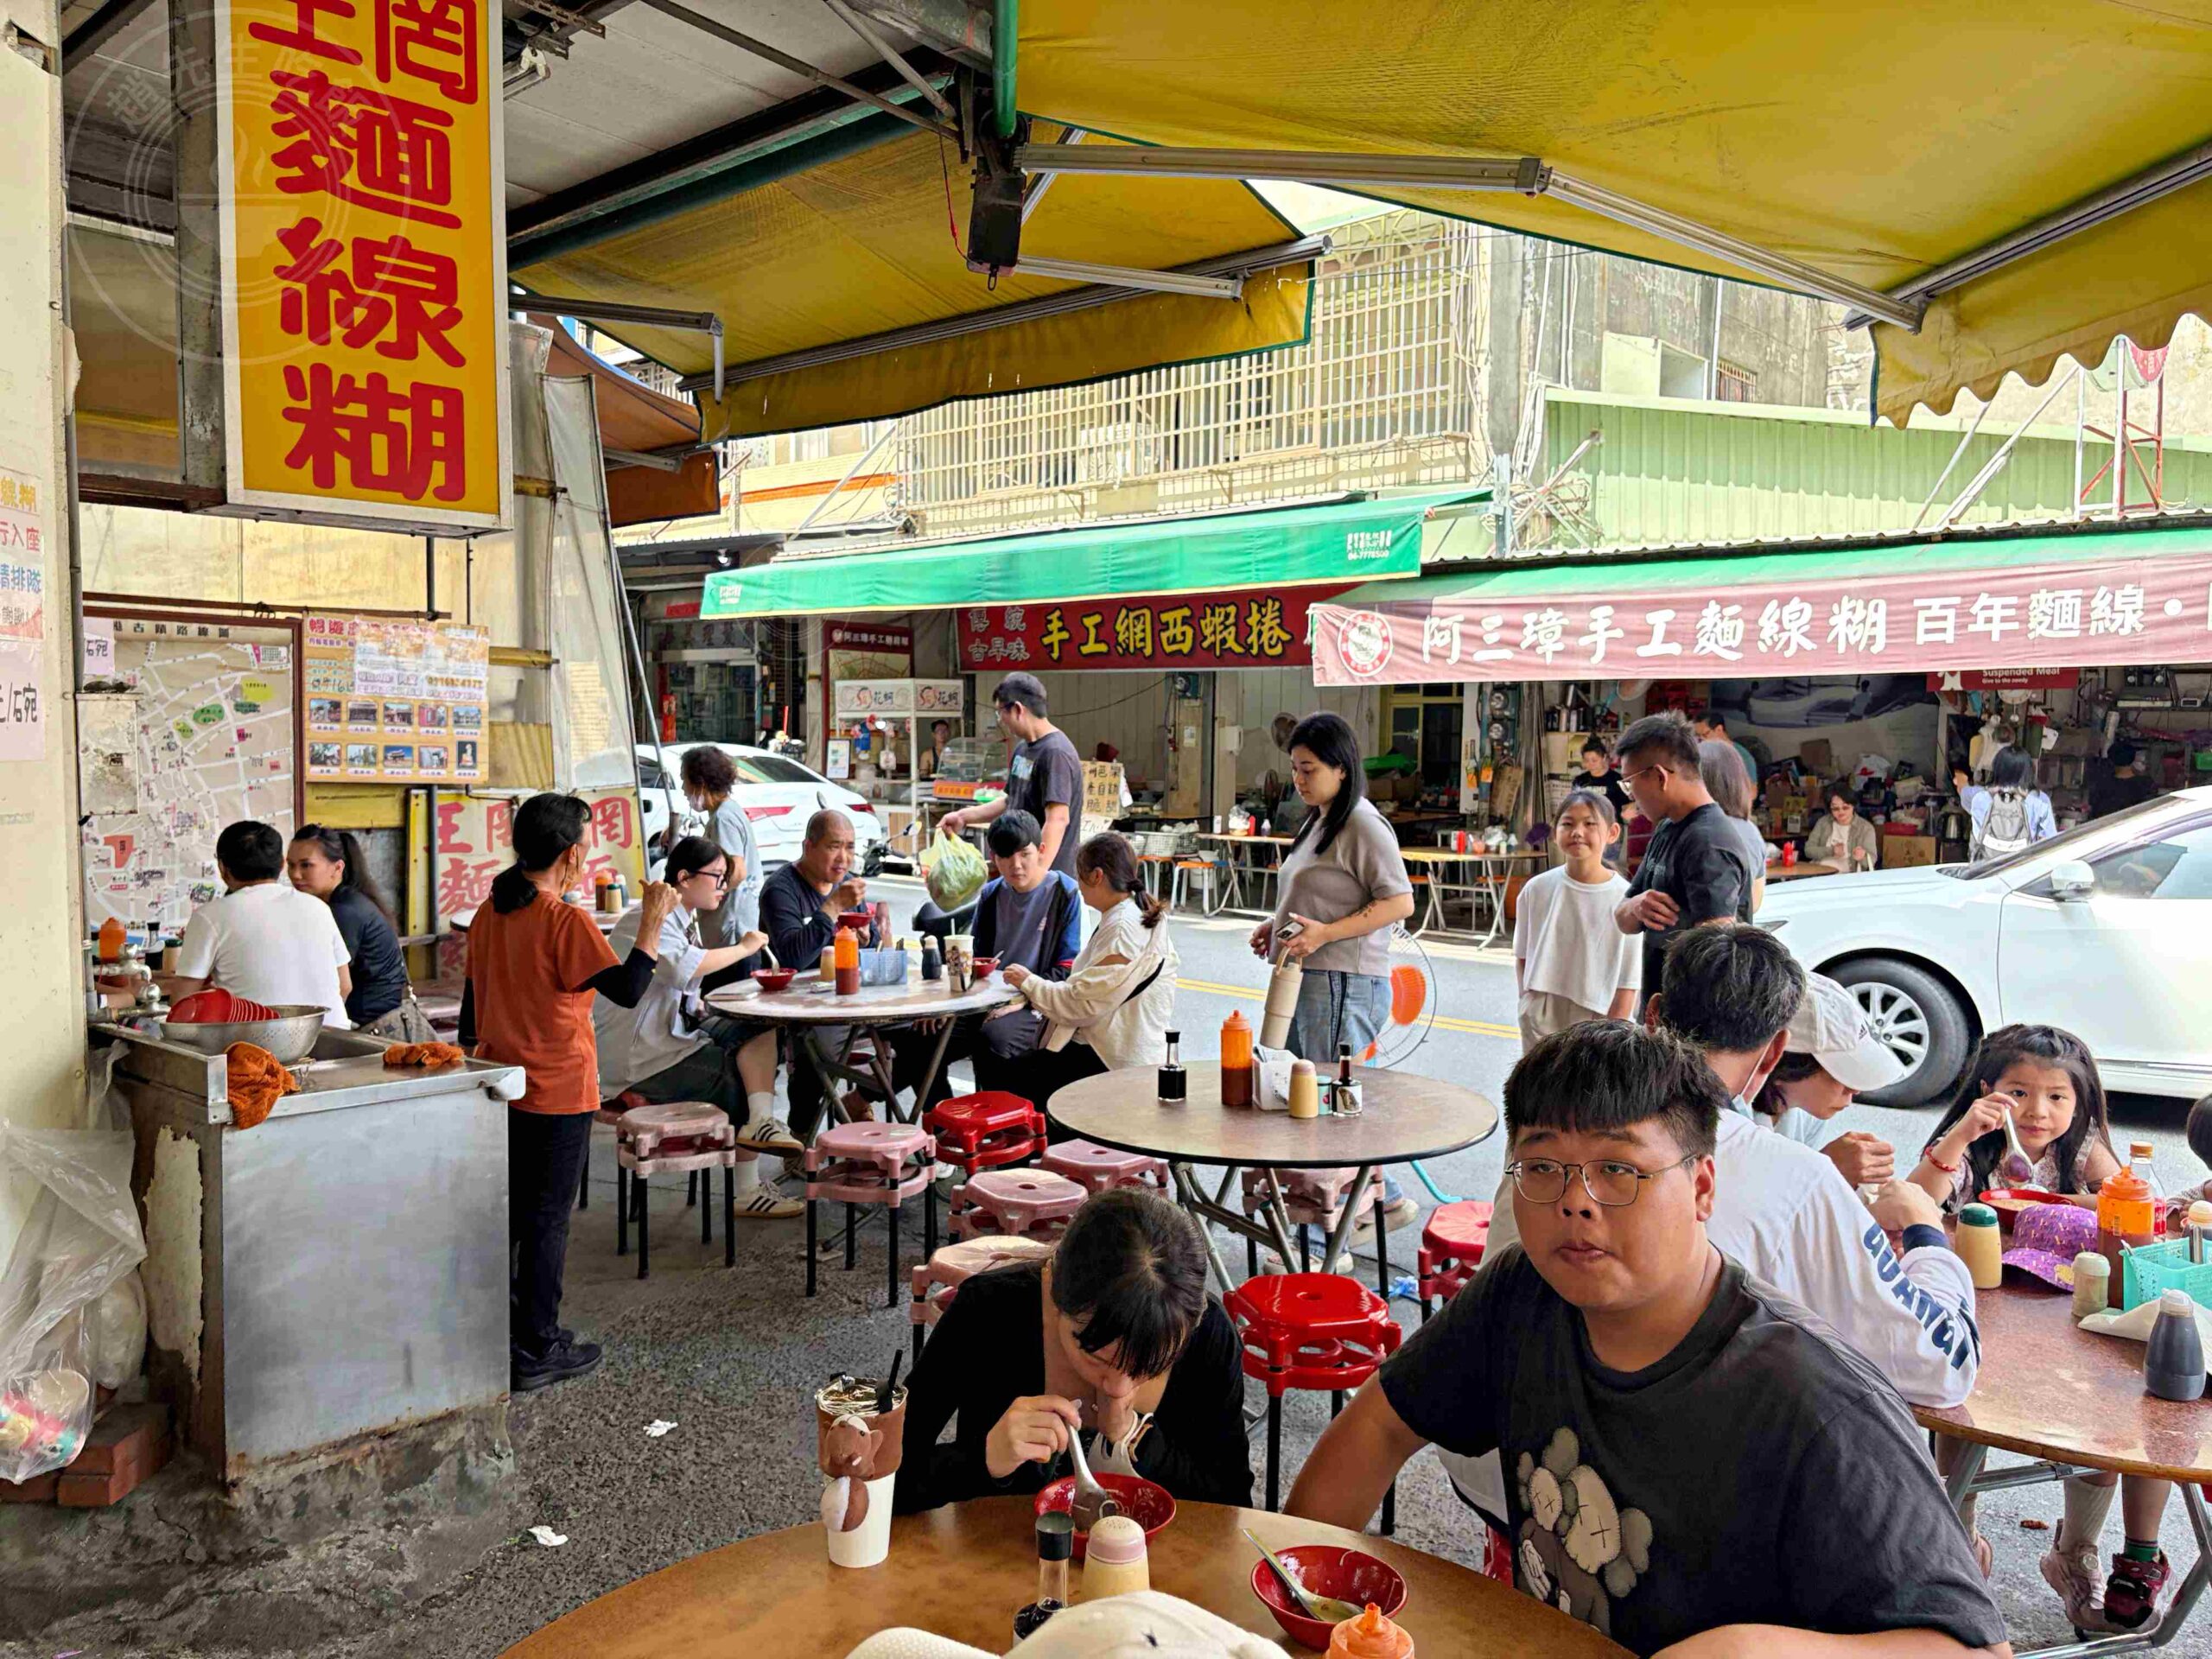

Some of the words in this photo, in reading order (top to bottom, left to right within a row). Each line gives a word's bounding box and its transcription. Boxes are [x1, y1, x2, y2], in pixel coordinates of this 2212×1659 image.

[270, 70, 467, 502] 麵線糊
[968, 637, 1031, 663] 古早味
[1040, 598, 1293, 661] 手工網西蝦捲
[1422, 595, 1887, 664] 阿三璋手工麵線糊
[1982, 668, 2033, 677] Suspended
[2036, 667, 2060, 676] Meal
